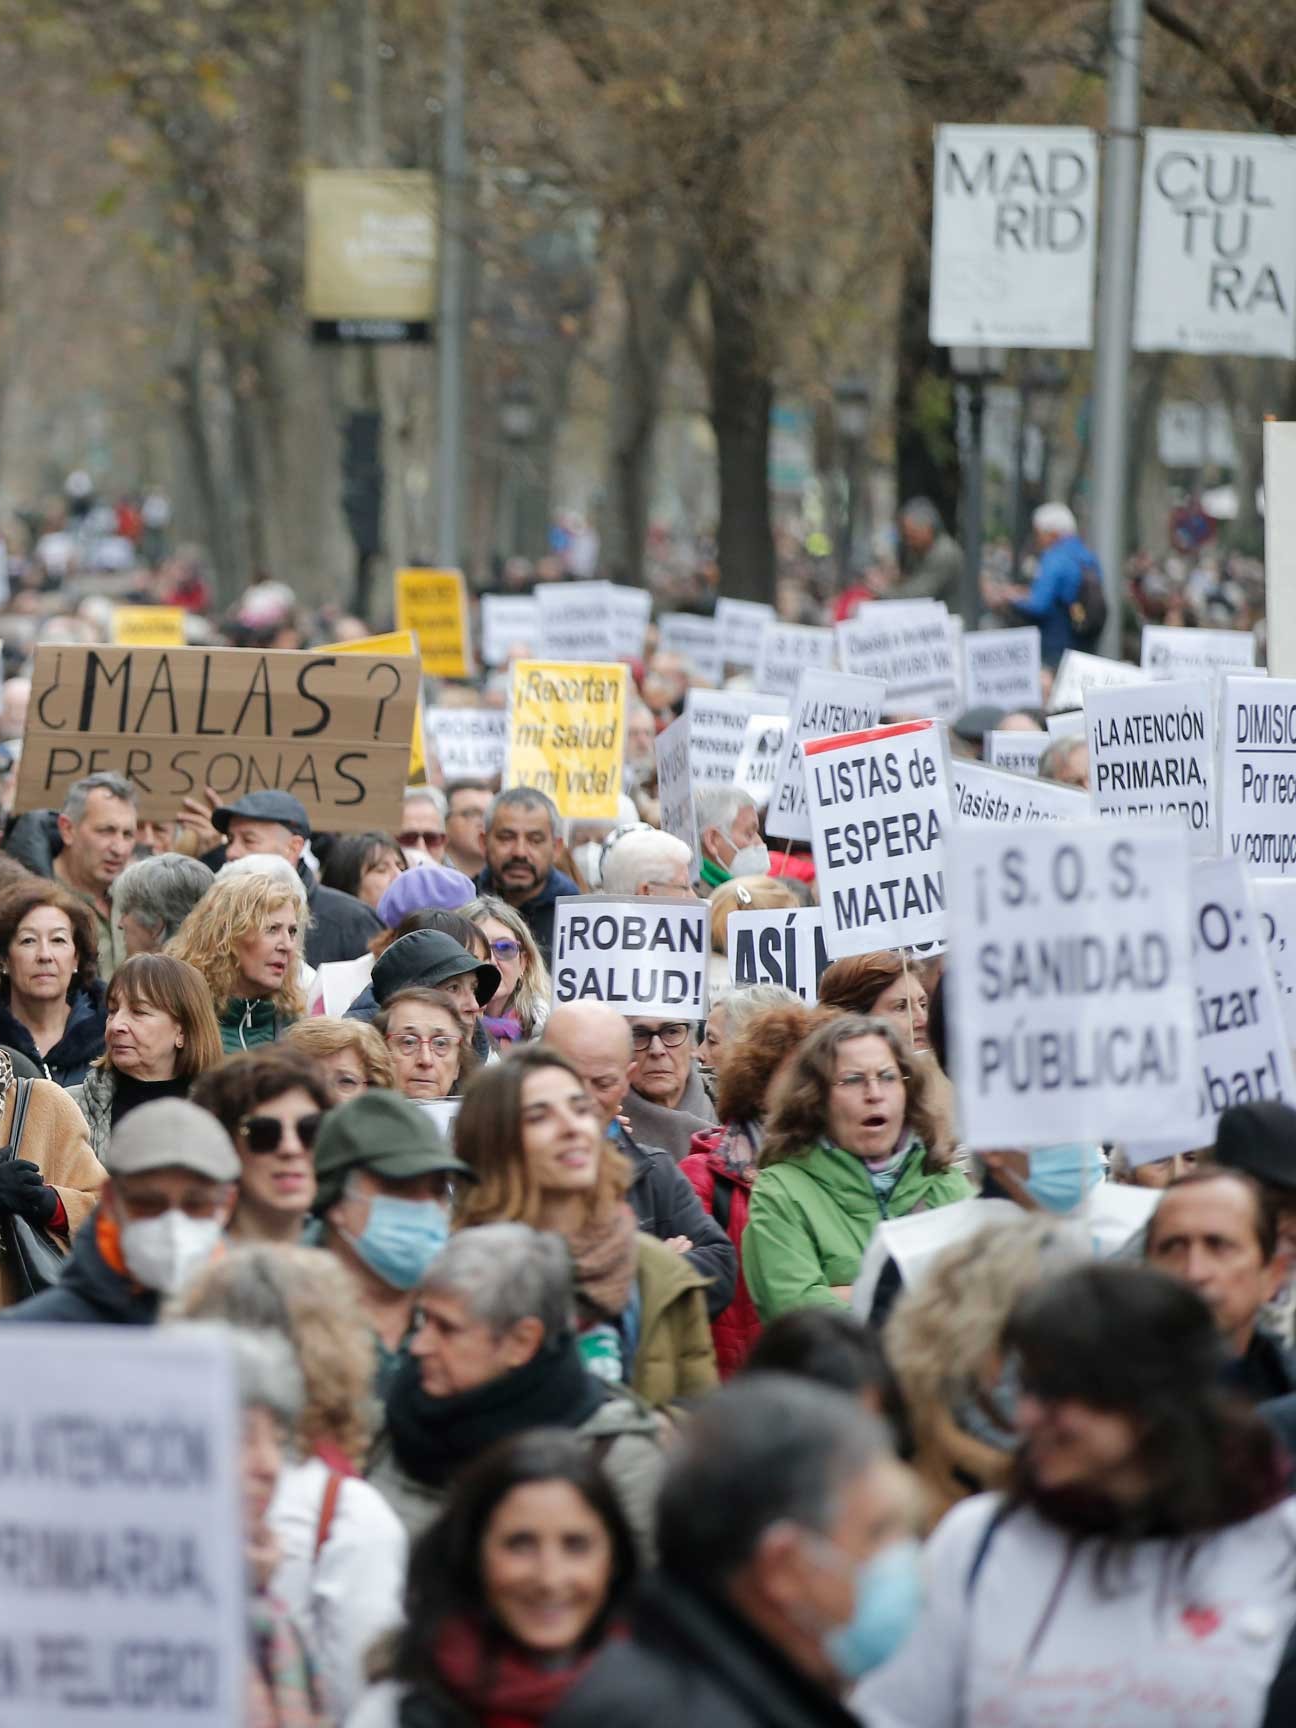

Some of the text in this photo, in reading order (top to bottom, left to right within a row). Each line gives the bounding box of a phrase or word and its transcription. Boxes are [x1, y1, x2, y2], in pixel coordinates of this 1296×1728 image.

[945, 148, 1088, 199] MAD
[1155, 151, 1273, 207] CUL
[995, 203, 1087, 253] RID
[1173, 207, 1251, 259] TU
[1209, 264, 1287, 317] RA
[516, 670, 619, 708] ¡Recortan
[515, 716, 618, 750] mi salud
[820, 700, 877, 733] ATENCIÓN
[1094, 703, 1204, 756] ¡LA ATENCIÓN
[45, 747, 368, 806] PERSONAS
[534, 762, 561, 794] mi
[565, 762, 617, 796] vida!
[778, 784, 800, 814] EN
[815, 752, 903, 807] LISTAS
[908, 748, 937, 790] de
[1096, 756, 1208, 792] PRIMARIA,
[1242, 763, 1270, 804] Por
[824, 808, 943, 869] ESPERA
[832, 871, 947, 931] MATAN
[558, 915, 703, 960] ¡ROBAN
[556, 966, 702, 1006] SALUD!
[977, 931, 1171, 1004] SANIDAD
[978, 1013, 1180, 1098] PÚBLICA!
